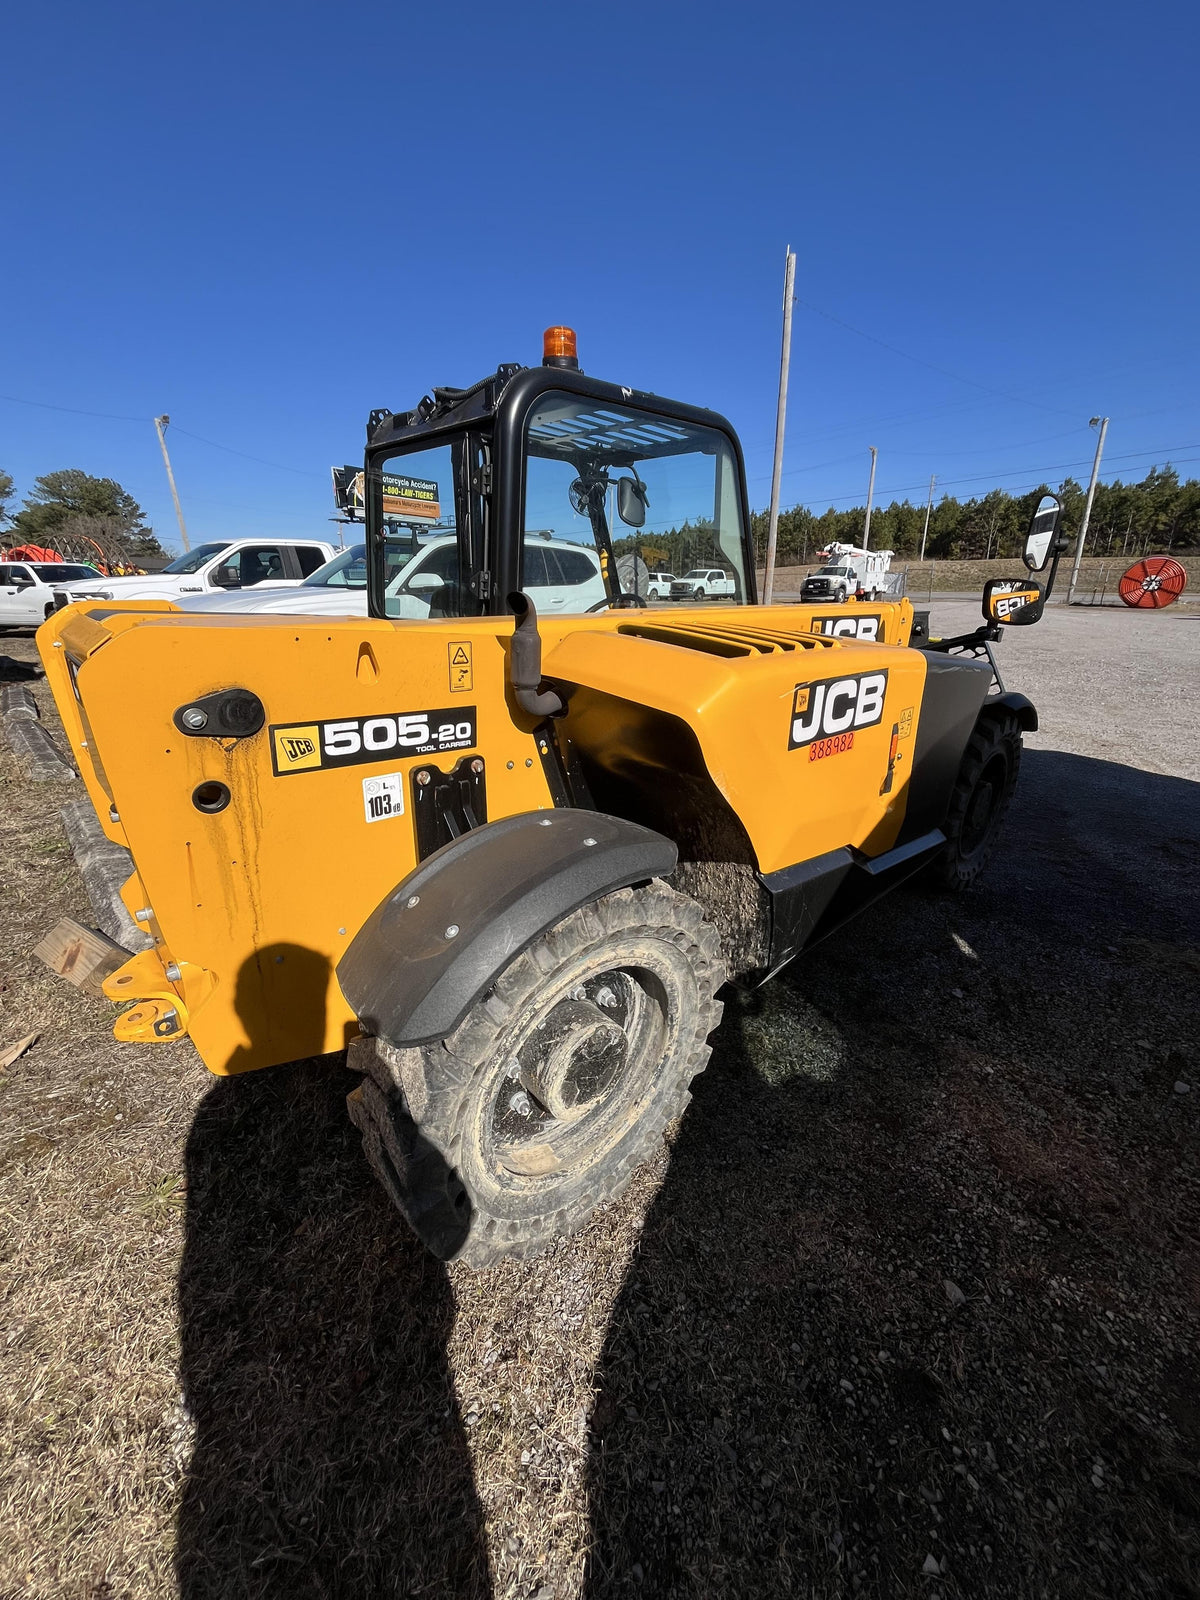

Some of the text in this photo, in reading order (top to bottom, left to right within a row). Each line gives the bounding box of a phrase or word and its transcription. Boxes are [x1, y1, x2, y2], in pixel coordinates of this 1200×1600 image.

[382, 476, 436, 490] otorcycle Accident?
[382, 485, 434, 500] 1-800-LAW-TIGERS
[792, 674, 886, 743] JCB
[287, 714, 472, 759] JCB 505-20
[416, 740, 472, 753] TOOL CARRIER
[809, 732, 854, 762] 388982
[368, 793, 401, 818] 103 dB
